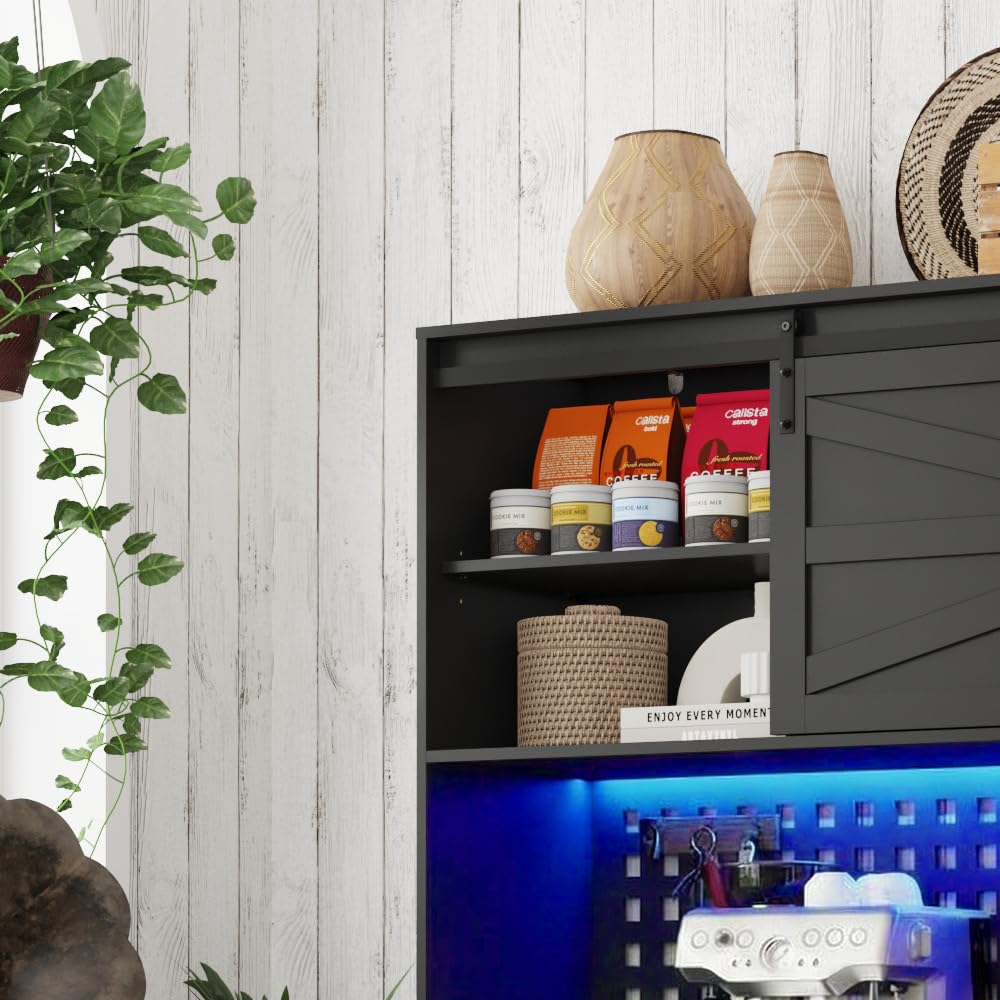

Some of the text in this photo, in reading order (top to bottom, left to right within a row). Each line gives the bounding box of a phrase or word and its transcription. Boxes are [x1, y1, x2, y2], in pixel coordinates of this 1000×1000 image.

[706, 453, 763, 465] fresh roasted
[647, 712, 682, 723] ENJOY
[686, 709, 721, 721] EVERY
